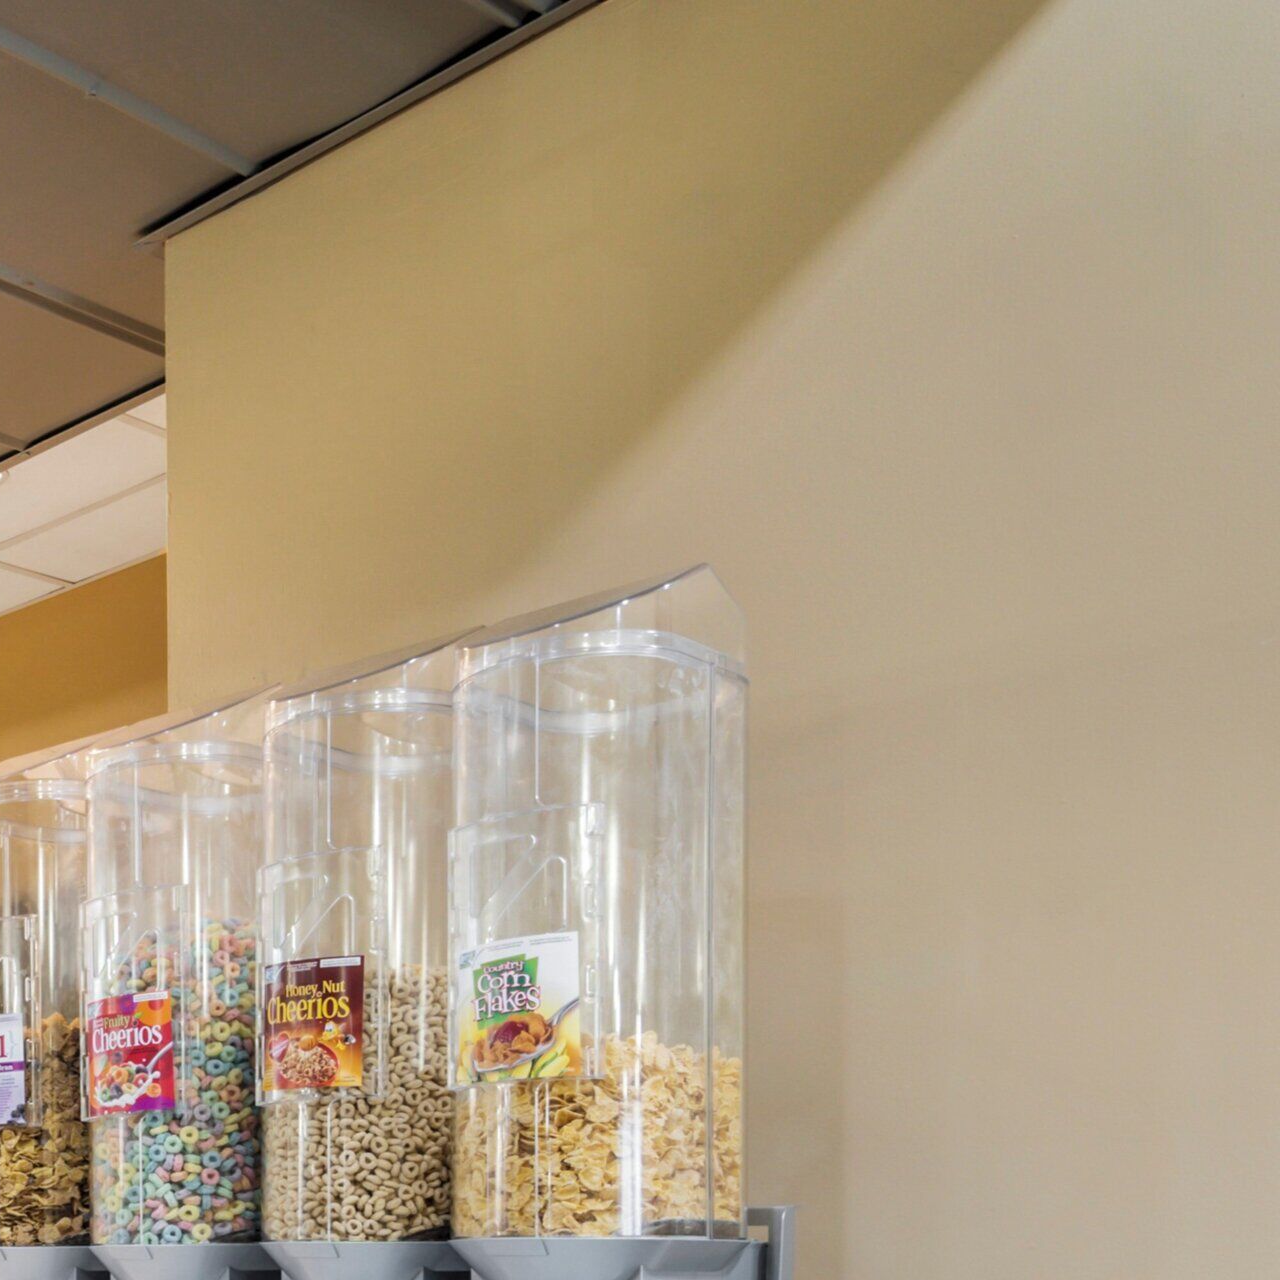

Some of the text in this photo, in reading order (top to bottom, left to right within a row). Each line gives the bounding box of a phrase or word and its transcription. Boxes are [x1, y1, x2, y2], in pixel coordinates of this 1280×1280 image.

[287, 980, 345, 998] Honey Nut
[478, 971, 531, 993] Corn
[268, 994, 349, 1025] Cheerios
[472, 986, 542, 1022] Flakes
[104, 1014, 130, 1029] Fruity
[93, 1025, 162, 1053] Cheerios
